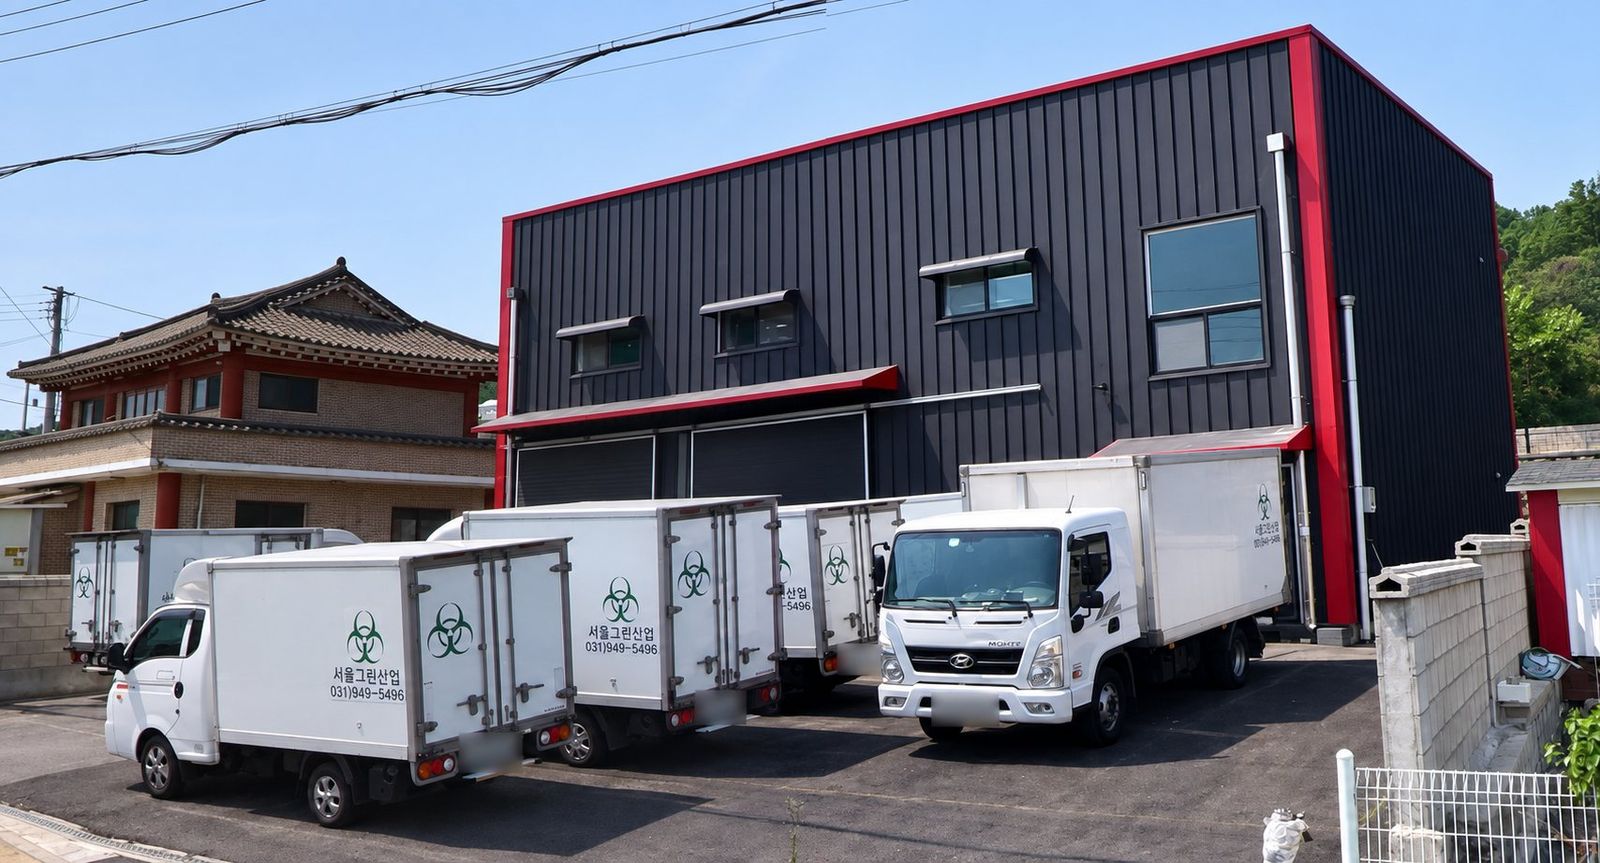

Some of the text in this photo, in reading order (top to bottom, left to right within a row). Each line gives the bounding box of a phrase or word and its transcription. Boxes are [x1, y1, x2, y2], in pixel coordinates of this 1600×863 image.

[782, 587, 807, 600] 산업
[588, 625, 654, 642] 서울그린산업
[585, 641, 658, 655] 031)949-5496
[333, 666, 400, 686] 서울그린산업
[330, 685, 405, 701] 031)949-5496
